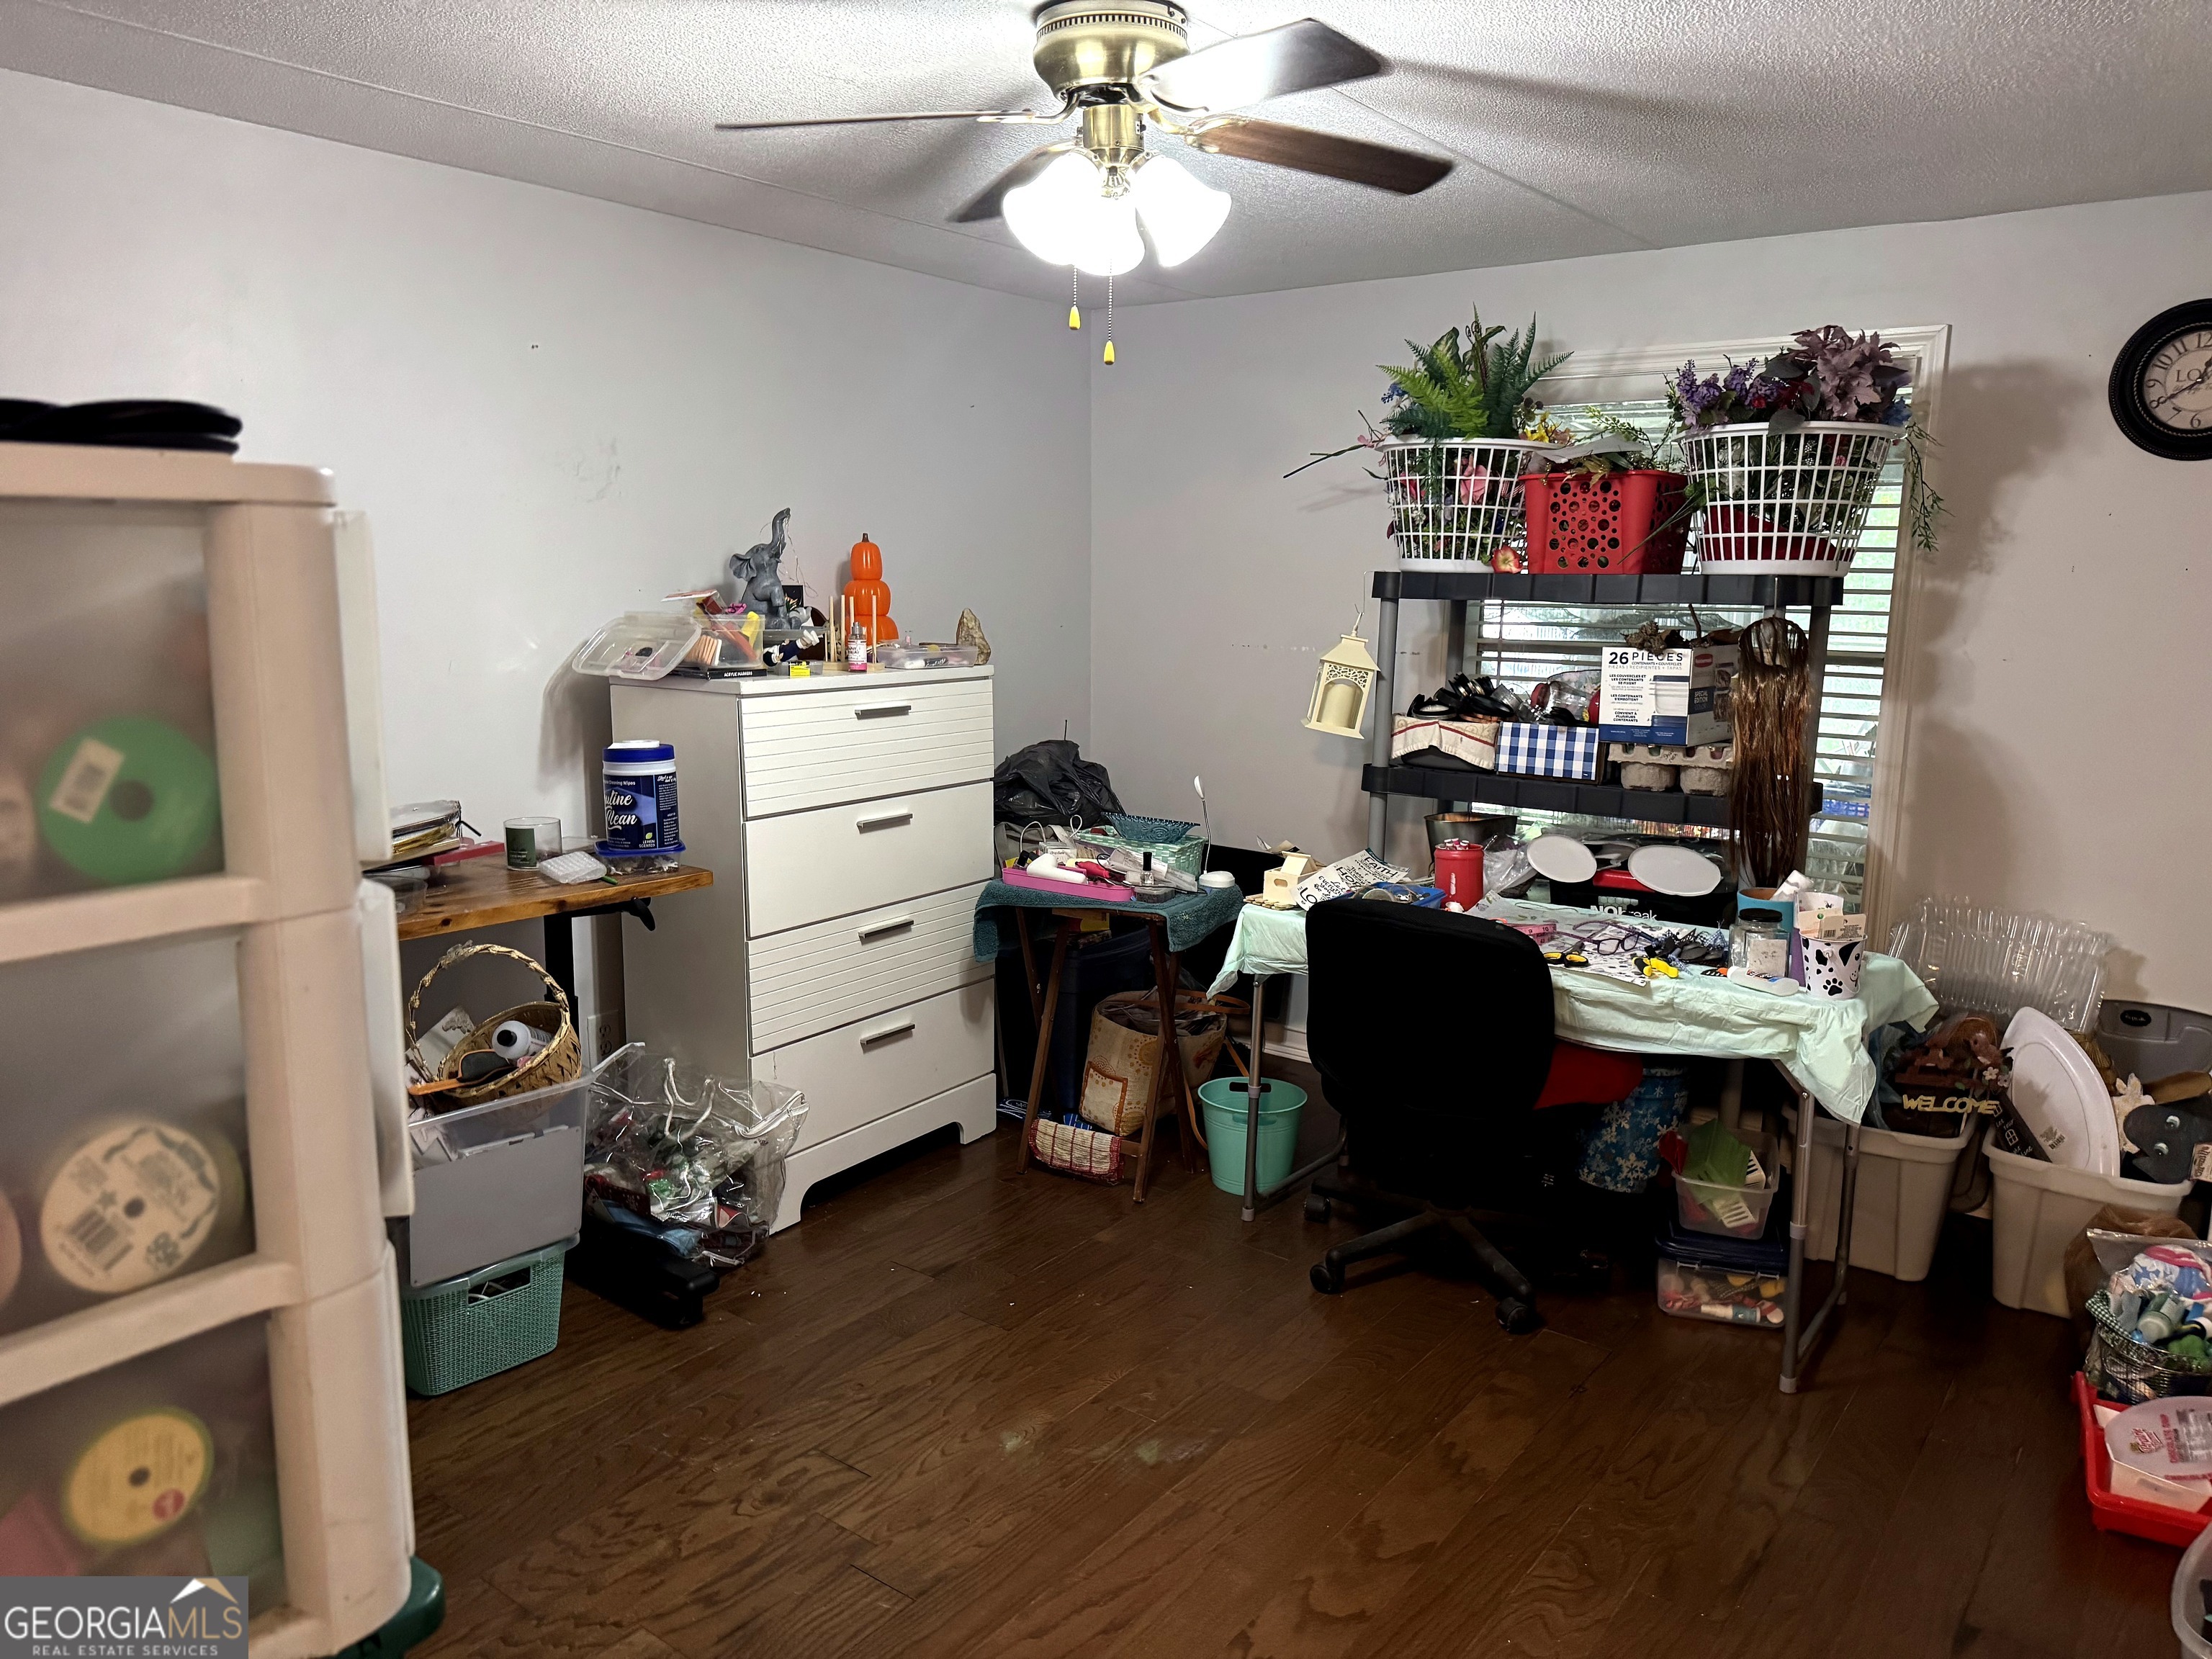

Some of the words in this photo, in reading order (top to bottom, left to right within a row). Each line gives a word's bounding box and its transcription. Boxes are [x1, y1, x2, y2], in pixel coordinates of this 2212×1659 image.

[2172, 338, 2188, 355] 11
[2197, 331, 2212, 349] 12
[2152, 354, 2173, 370] 10
[2146, 378, 2165, 388] 9
[2149, 396, 2167, 409] 8
[2165, 407, 2182, 423] 7
[2190, 413, 2201, 428] 6
[1609, 652, 1629, 665] 26
[605, 789, 633, 806] utine
[606, 805, 637, 830] Clean
[1364, 856, 1398, 878] FAITH
[1336, 866, 1362, 887] HOP
[1300, 887, 1318, 904] LO
[1902, 1094, 2000, 1115] WELCOME
